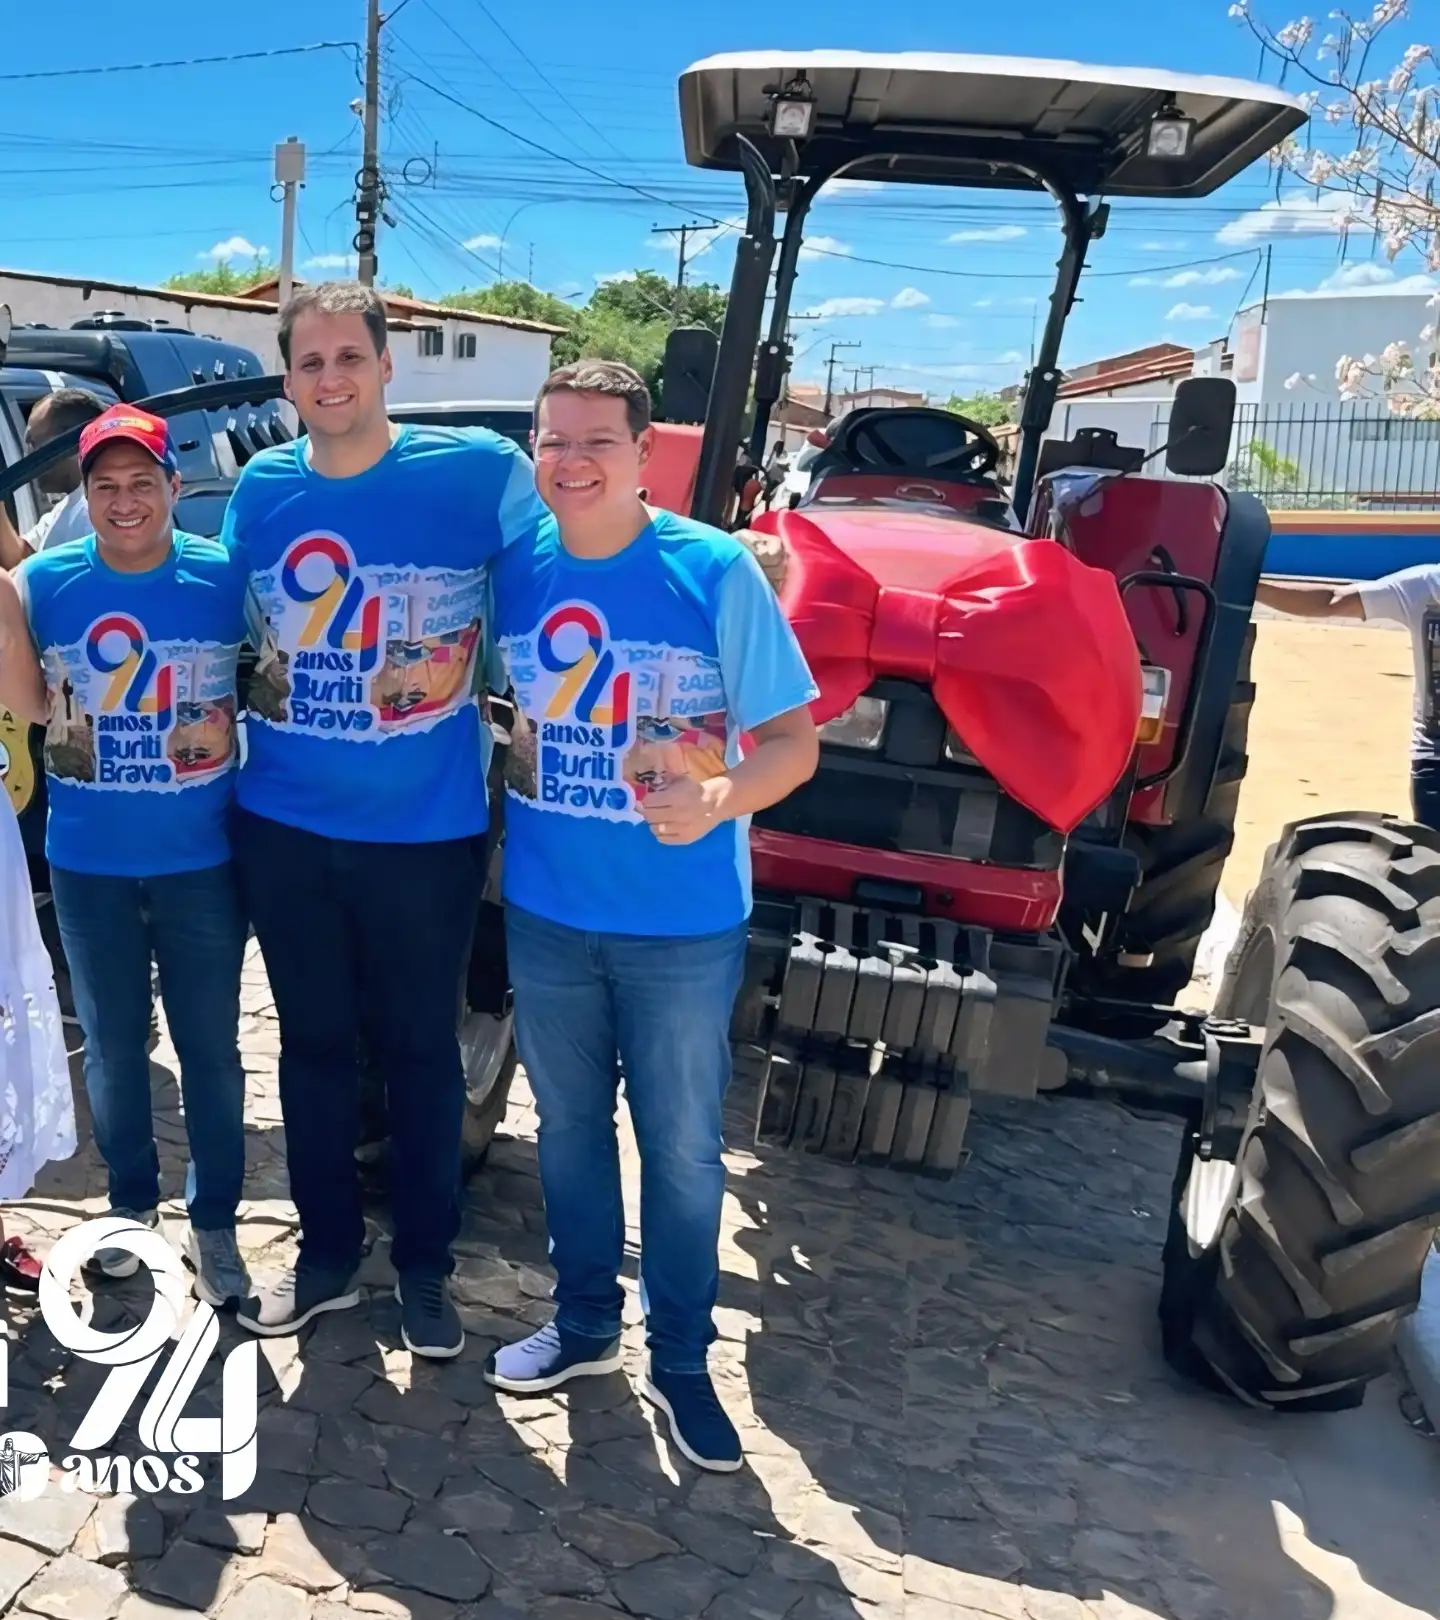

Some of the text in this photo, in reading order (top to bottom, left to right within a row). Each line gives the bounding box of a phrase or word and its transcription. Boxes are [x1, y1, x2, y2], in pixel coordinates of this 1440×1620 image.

[281, 537, 381, 673] 94
[86, 616, 172, 731] 94
[294, 650, 354, 672] anos
[292, 672, 363, 703] Buriti
[537, 606, 631, 748] 94
[97, 714, 153, 732] anos
[290, 700, 374, 731] Bravo
[97, 734, 162, 760] Buriti
[542, 722, 606, 748] anos
[99, 758, 173, 784] Bravo
[541, 745, 615, 781] Buriti
[541, 774, 628, 810] Bravo
